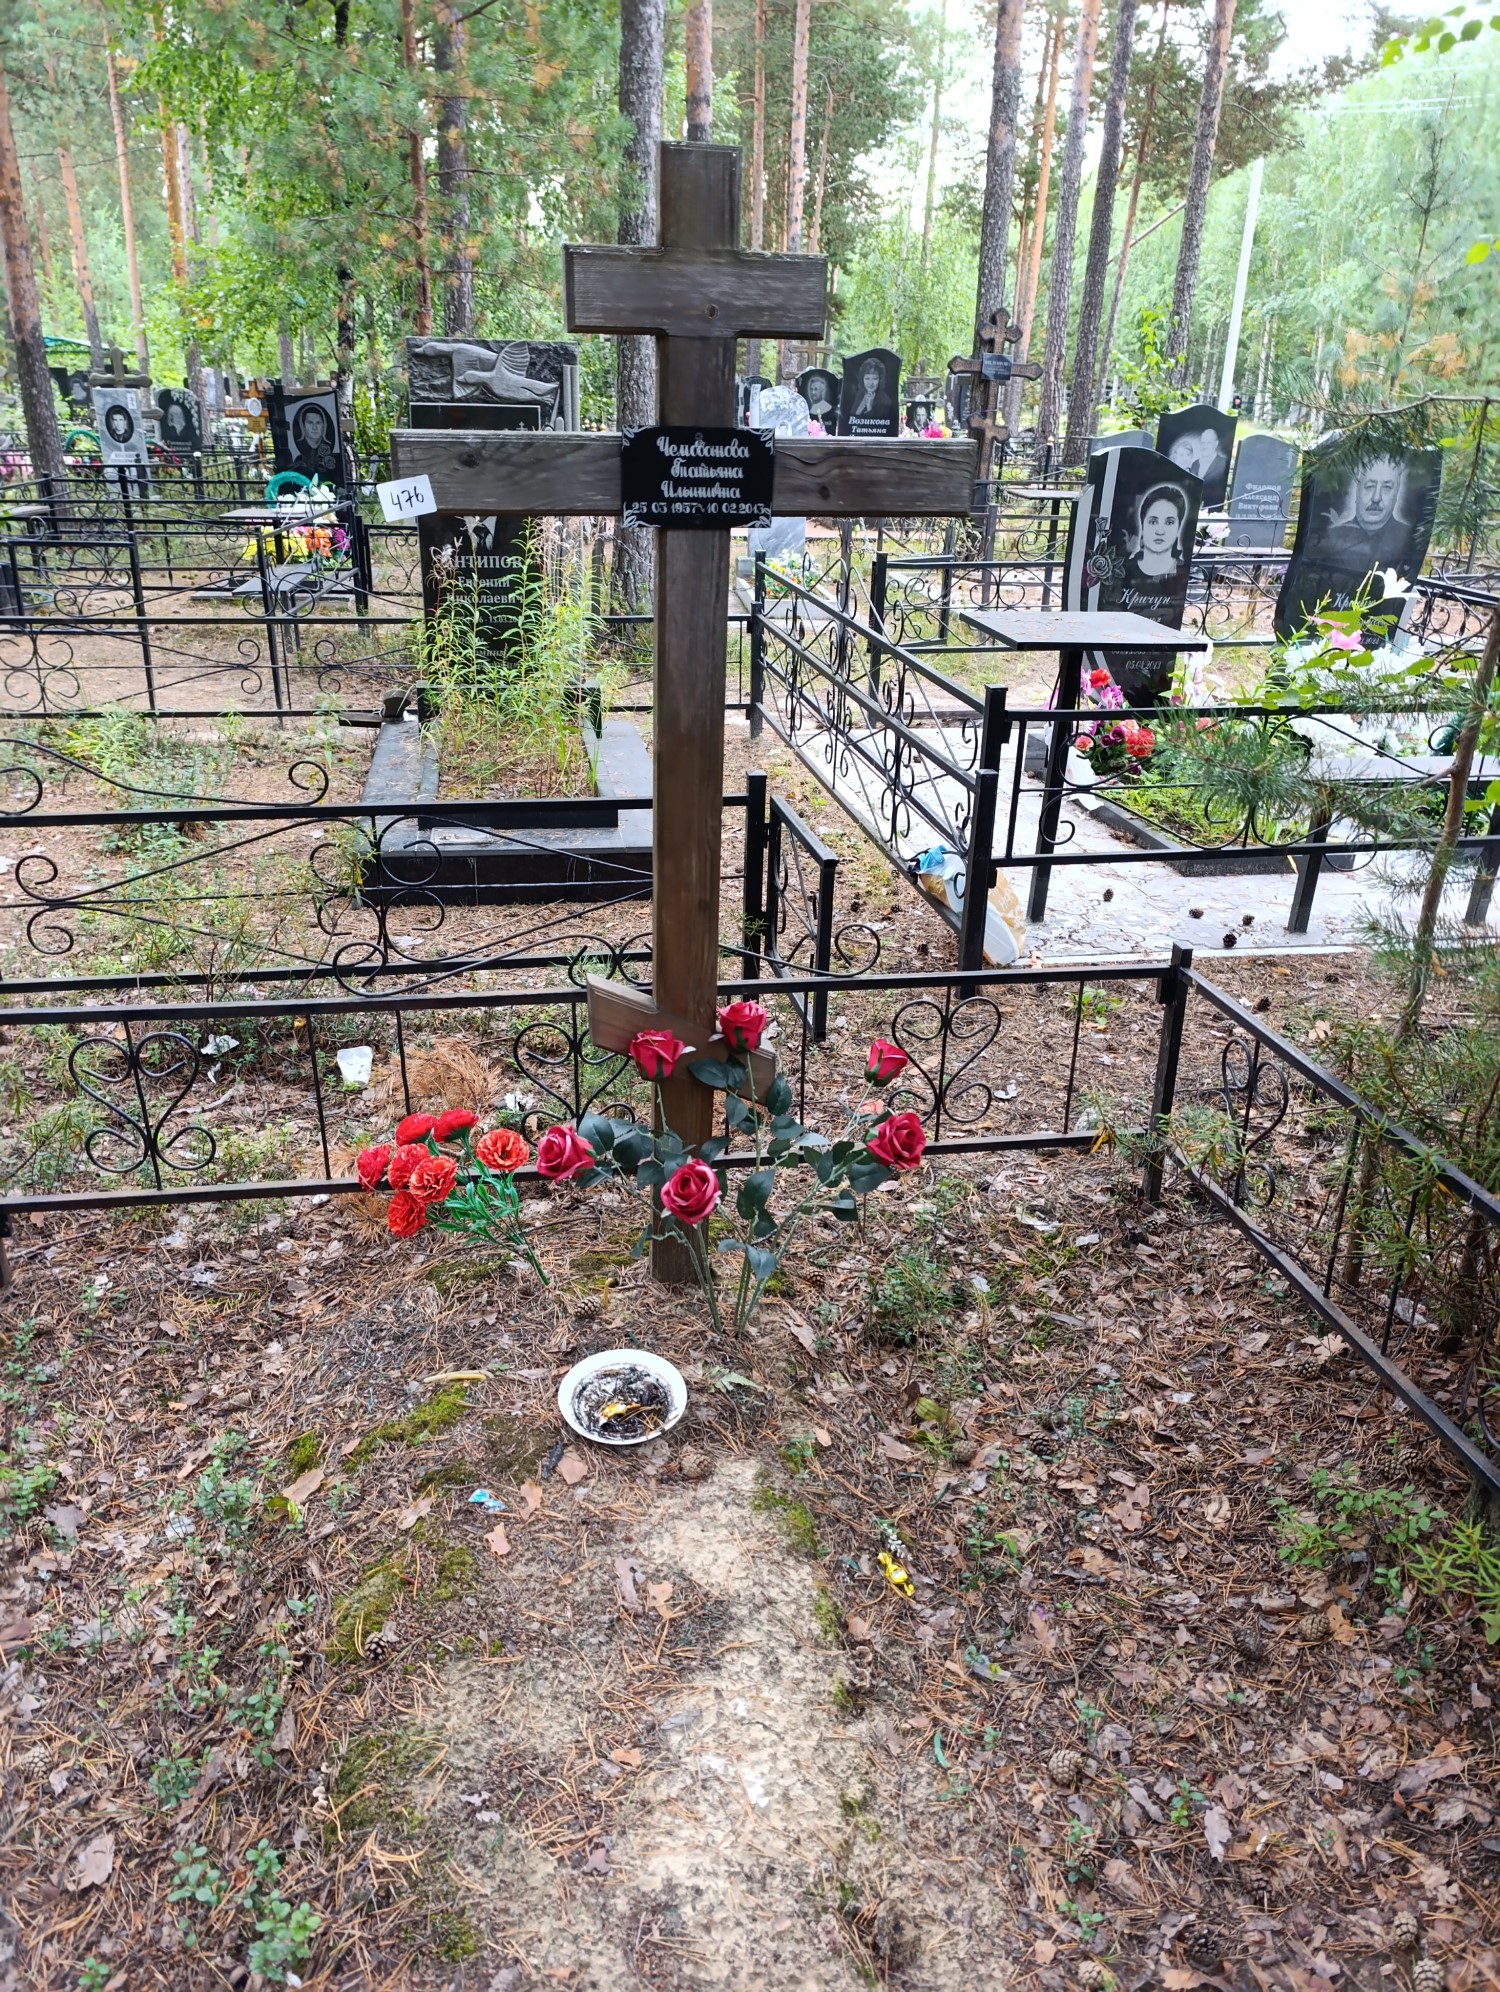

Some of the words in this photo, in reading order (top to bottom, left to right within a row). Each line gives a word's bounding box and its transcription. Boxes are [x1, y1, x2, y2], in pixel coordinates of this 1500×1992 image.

[851, 426, 887, 434] Татьяна
[670, 457, 744, 479] Татьяна
[390, 485, 425, 512] 476
[446, 555, 523, 568] НТИПОВ
